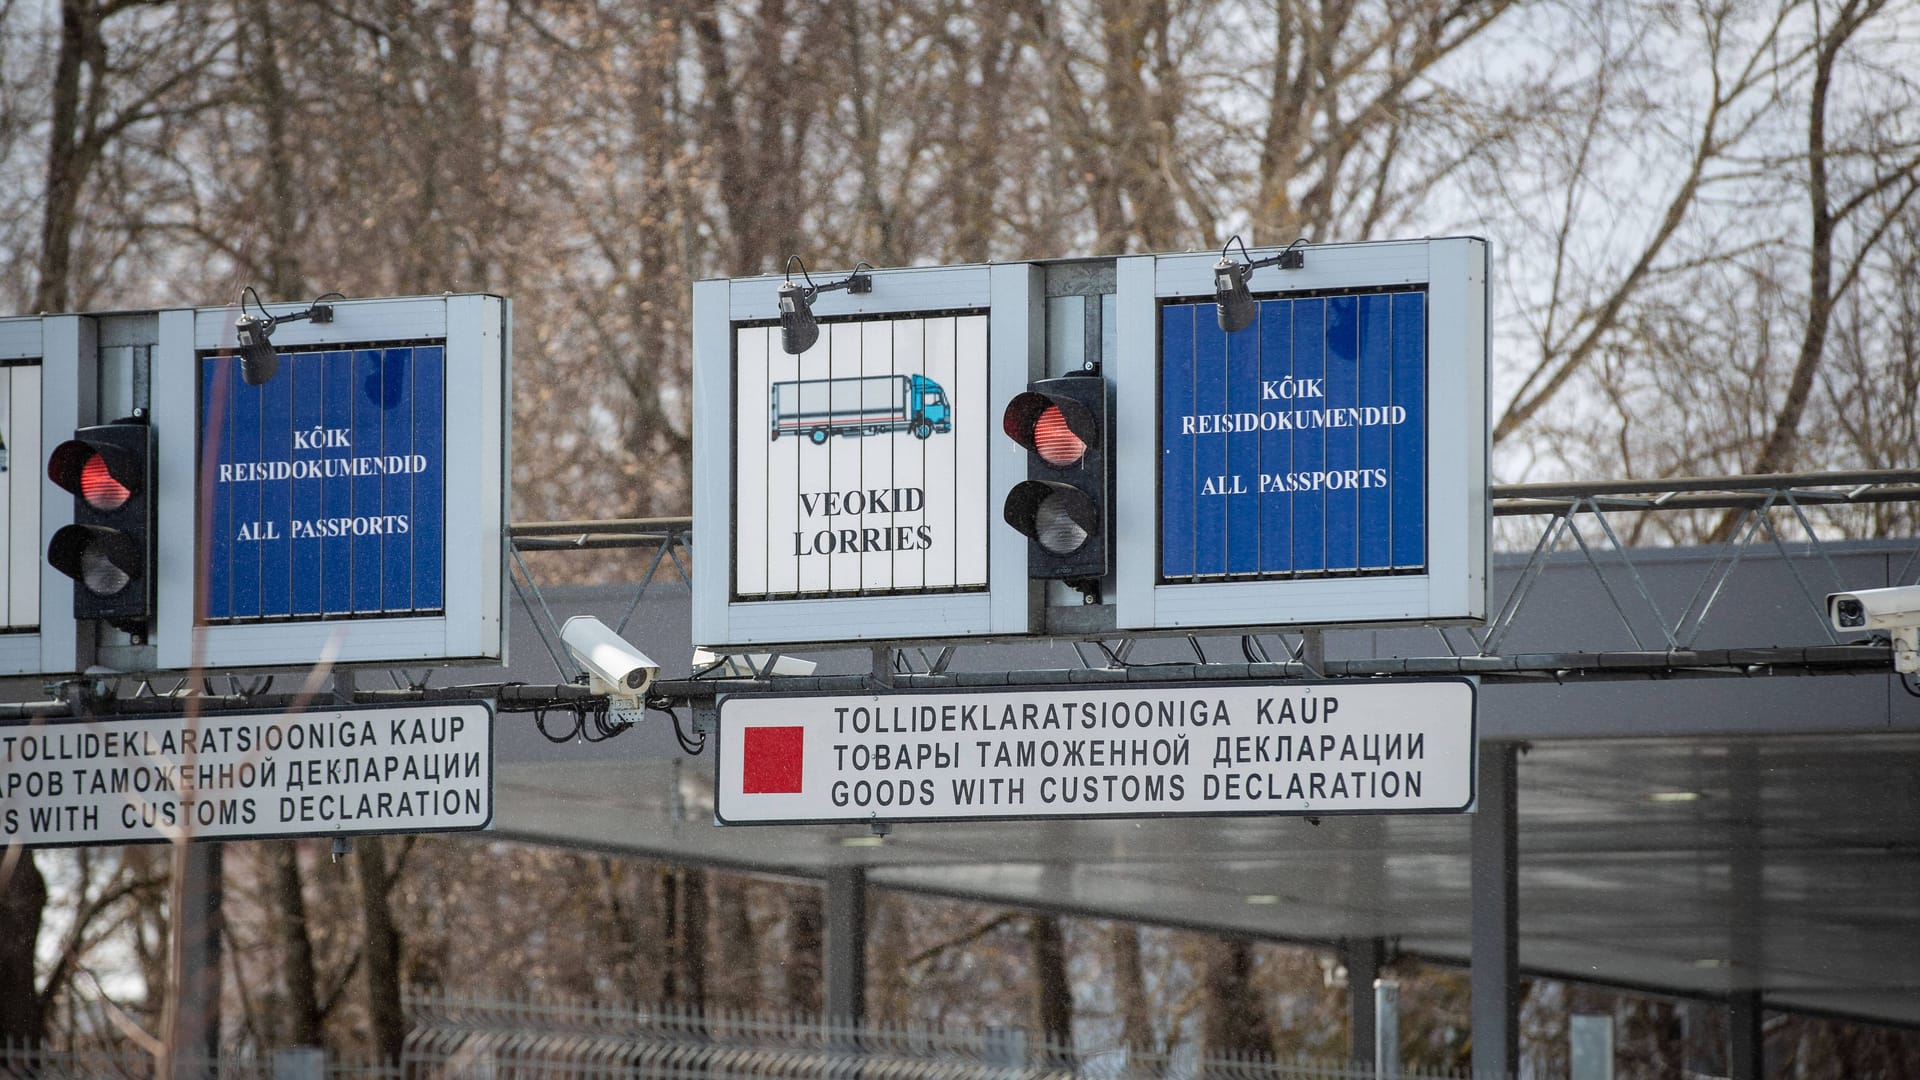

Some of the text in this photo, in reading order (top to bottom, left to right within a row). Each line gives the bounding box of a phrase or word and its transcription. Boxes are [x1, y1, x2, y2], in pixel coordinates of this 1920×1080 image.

[1262, 376, 1324, 400] KÕIK
[1181, 405, 1407, 435] REISIDOKUMENDID
[293, 426, 351, 449] KÕIK
[219, 454, 427, 482] REISIDOKUMENDID
[1201, 468, 1388, 496] ALL PASSPORTS
[800, 487, 924, 518] VEOKID
[237, 515, 409, 541] ALL PASSPORTS
[793, 524, 932, 556] LORRIES
[834, 697, 1339, 734] TOLLIDEKLARATSIOONIGA KAUP
[3, 716, 465, 763] TOLLIDEKLARATSIOONIGA KAUP
[833, 733, 1425, 771] ТОВАРЫ ТАМОЖЕННОЙ ДЕКЛАРАЦИИ
[73, 756, 277, 796] ТАМОЖЕННОЙ
[286, 752, 481, 792] ДЕКЛАРАЦИИ
[831, 770, 1422, 807] GOODS WITH CUSTOMS DECLARATION
[0, 788, 481, 835] S WITH CUSTOMS DECLARATION
